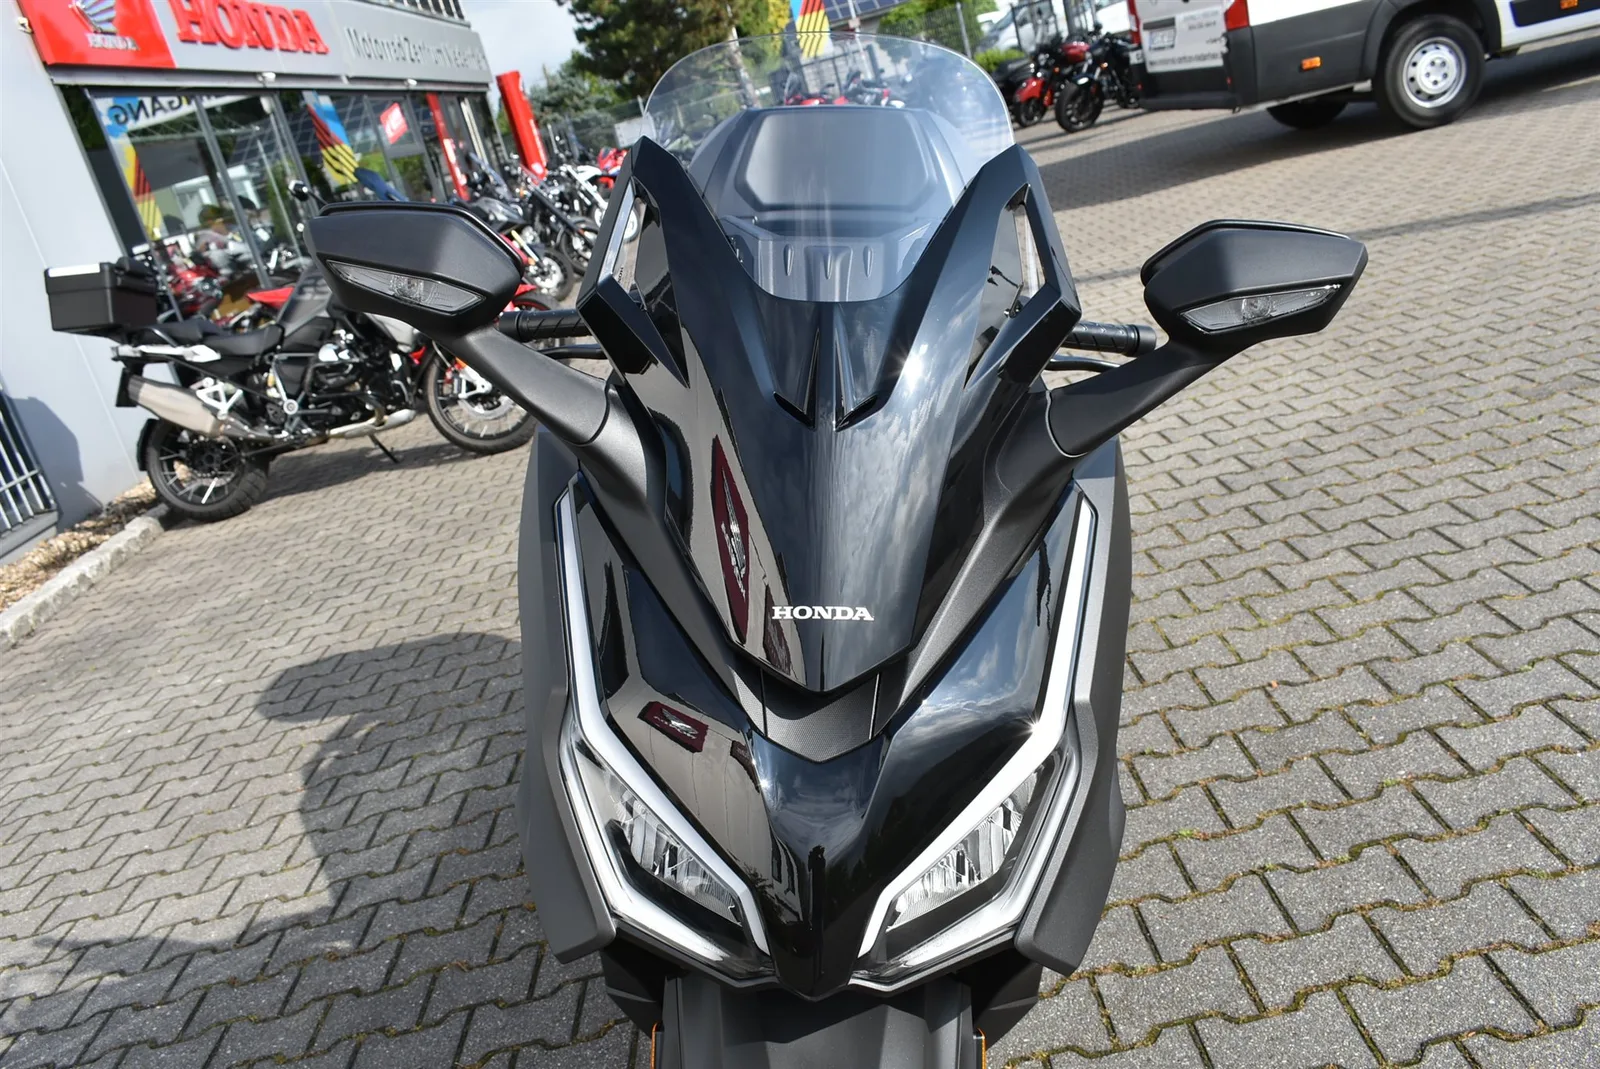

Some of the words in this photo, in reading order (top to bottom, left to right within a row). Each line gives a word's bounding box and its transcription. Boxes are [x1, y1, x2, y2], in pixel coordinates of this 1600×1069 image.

[167, 0, 330, 54] HONDA
[86, 33, 139, 51] HONDA
[771, 605, 875, 621] HONDA
